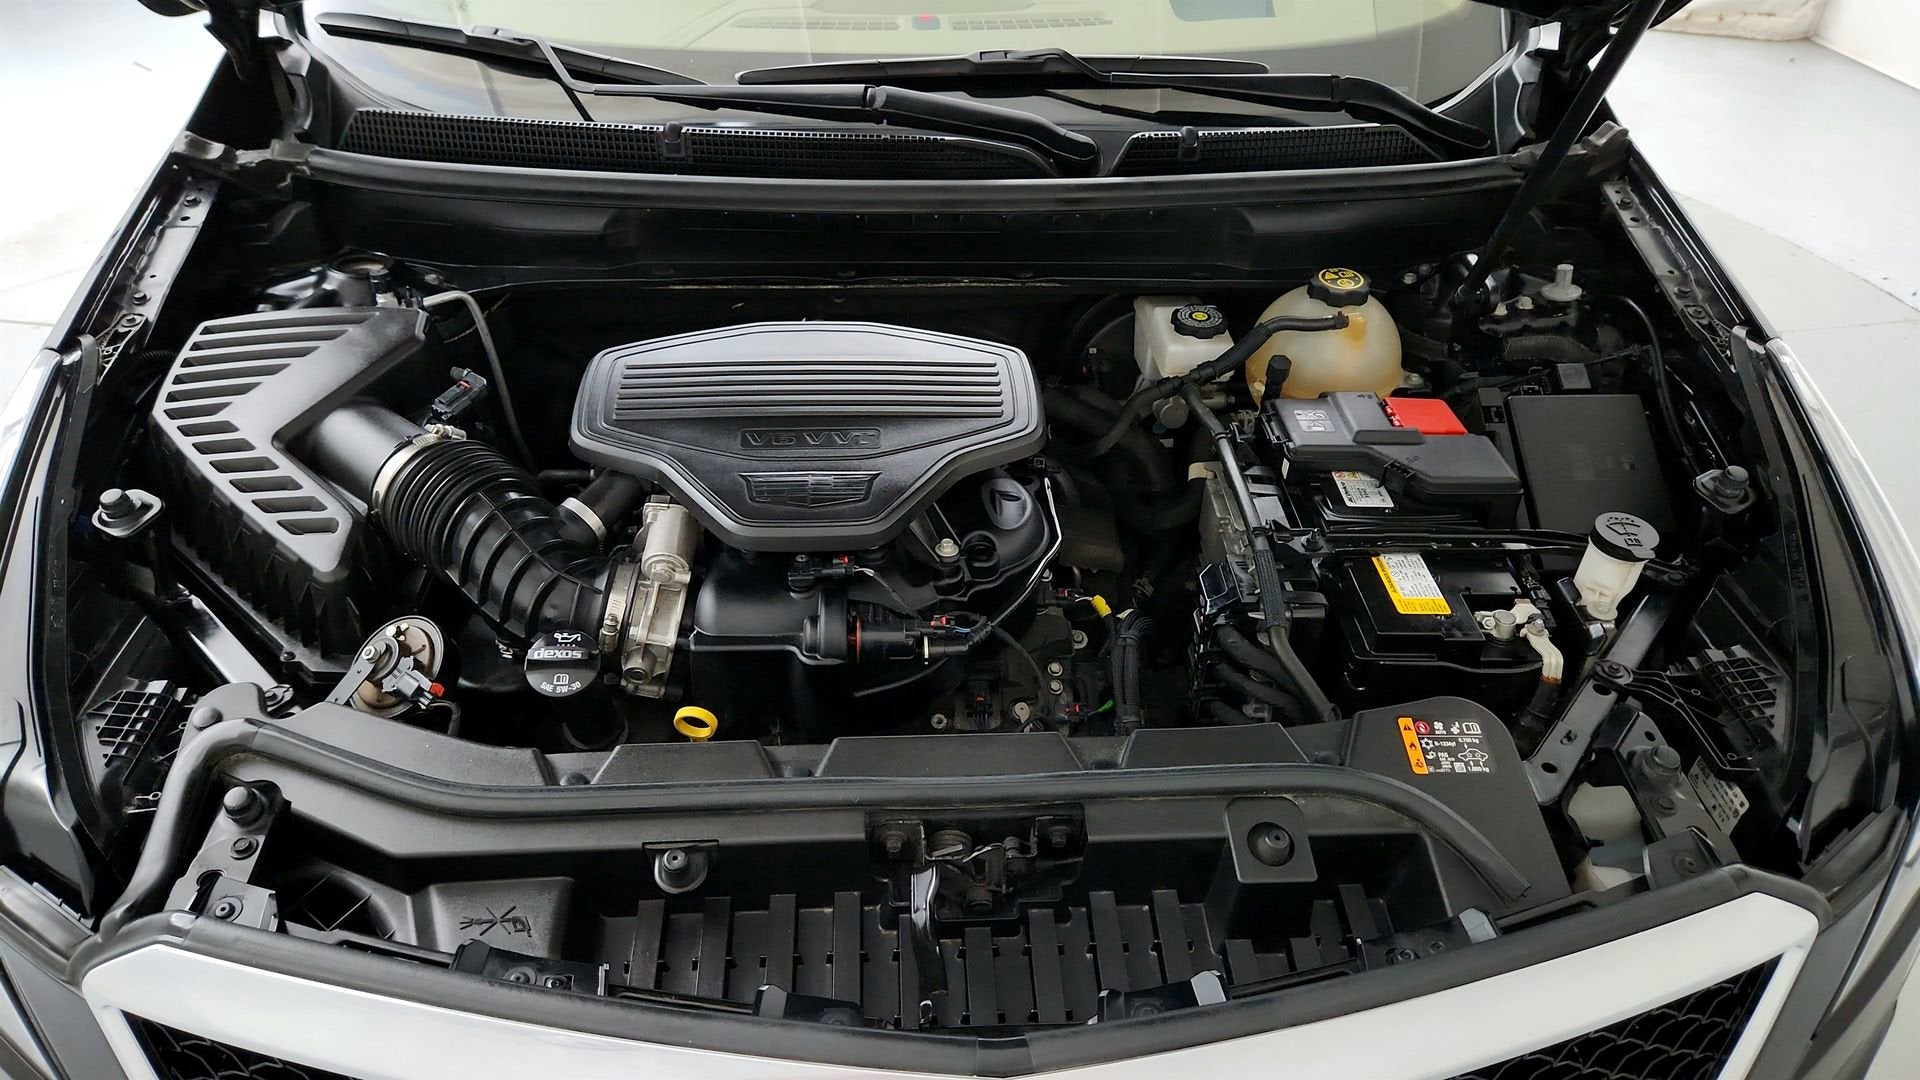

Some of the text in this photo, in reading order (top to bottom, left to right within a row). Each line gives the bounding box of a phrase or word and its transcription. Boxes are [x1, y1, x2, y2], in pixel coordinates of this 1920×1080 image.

[745, 431, 796, 446] V6
[534, 648, 583, 659] dexos
[540, 681, 582, 693] SAE 5W-30
